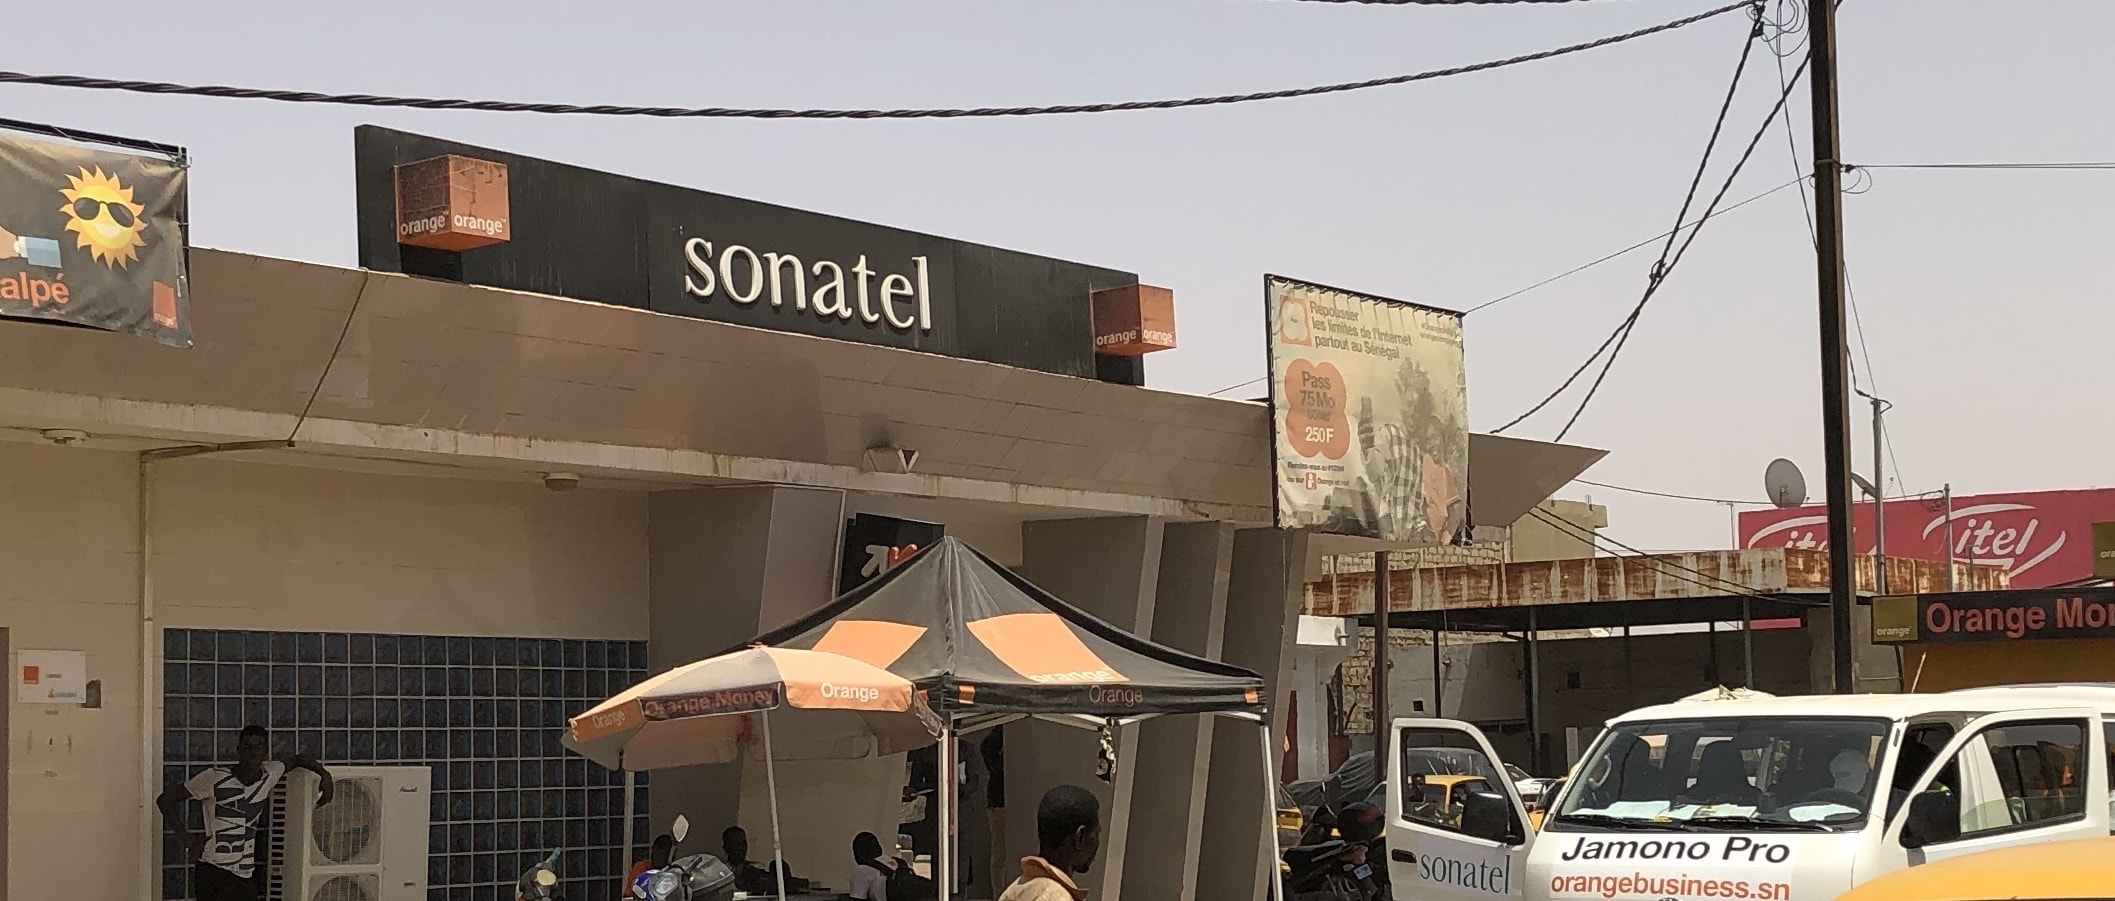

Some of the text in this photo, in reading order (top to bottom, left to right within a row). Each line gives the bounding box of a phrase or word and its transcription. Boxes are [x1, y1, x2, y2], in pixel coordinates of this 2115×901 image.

[401, 214, 446, 235] orange
[454, 214, 503, 235] orange
[684, 237, 931, 330] sonatel
[1309, 300, 1359, 321] Repousser
[1096, 330, 1137, 345] orange
[1143, 329, 1173, 344] orange
[1312, 316, 1327, 331] les
[1328, 318, 1359, 336] limites
[1360, 326, 1372, 339] de
[1315, 335, 1350, 351] partout
[1351, 341, 1363, 352] au
[1301, 371, 1331, 390] Pass
[1955, 519, 2038, 555] itel
[1926, 602, 2047, 639] Orange
[1876, 627, 1910, 637] orange
[644, 687, 774, 717] Orange Money
[820, 682, 879, 702] Orange
[1089, 685, 1143, 707] Orange
[592, 709, 626, 729] Orange
[1561, 836, 1790, 863] Jamono Pro
[1419, 853, 1511, 894] sonatel
[1550, 872, 1790, 901] orangebusiness.sn
